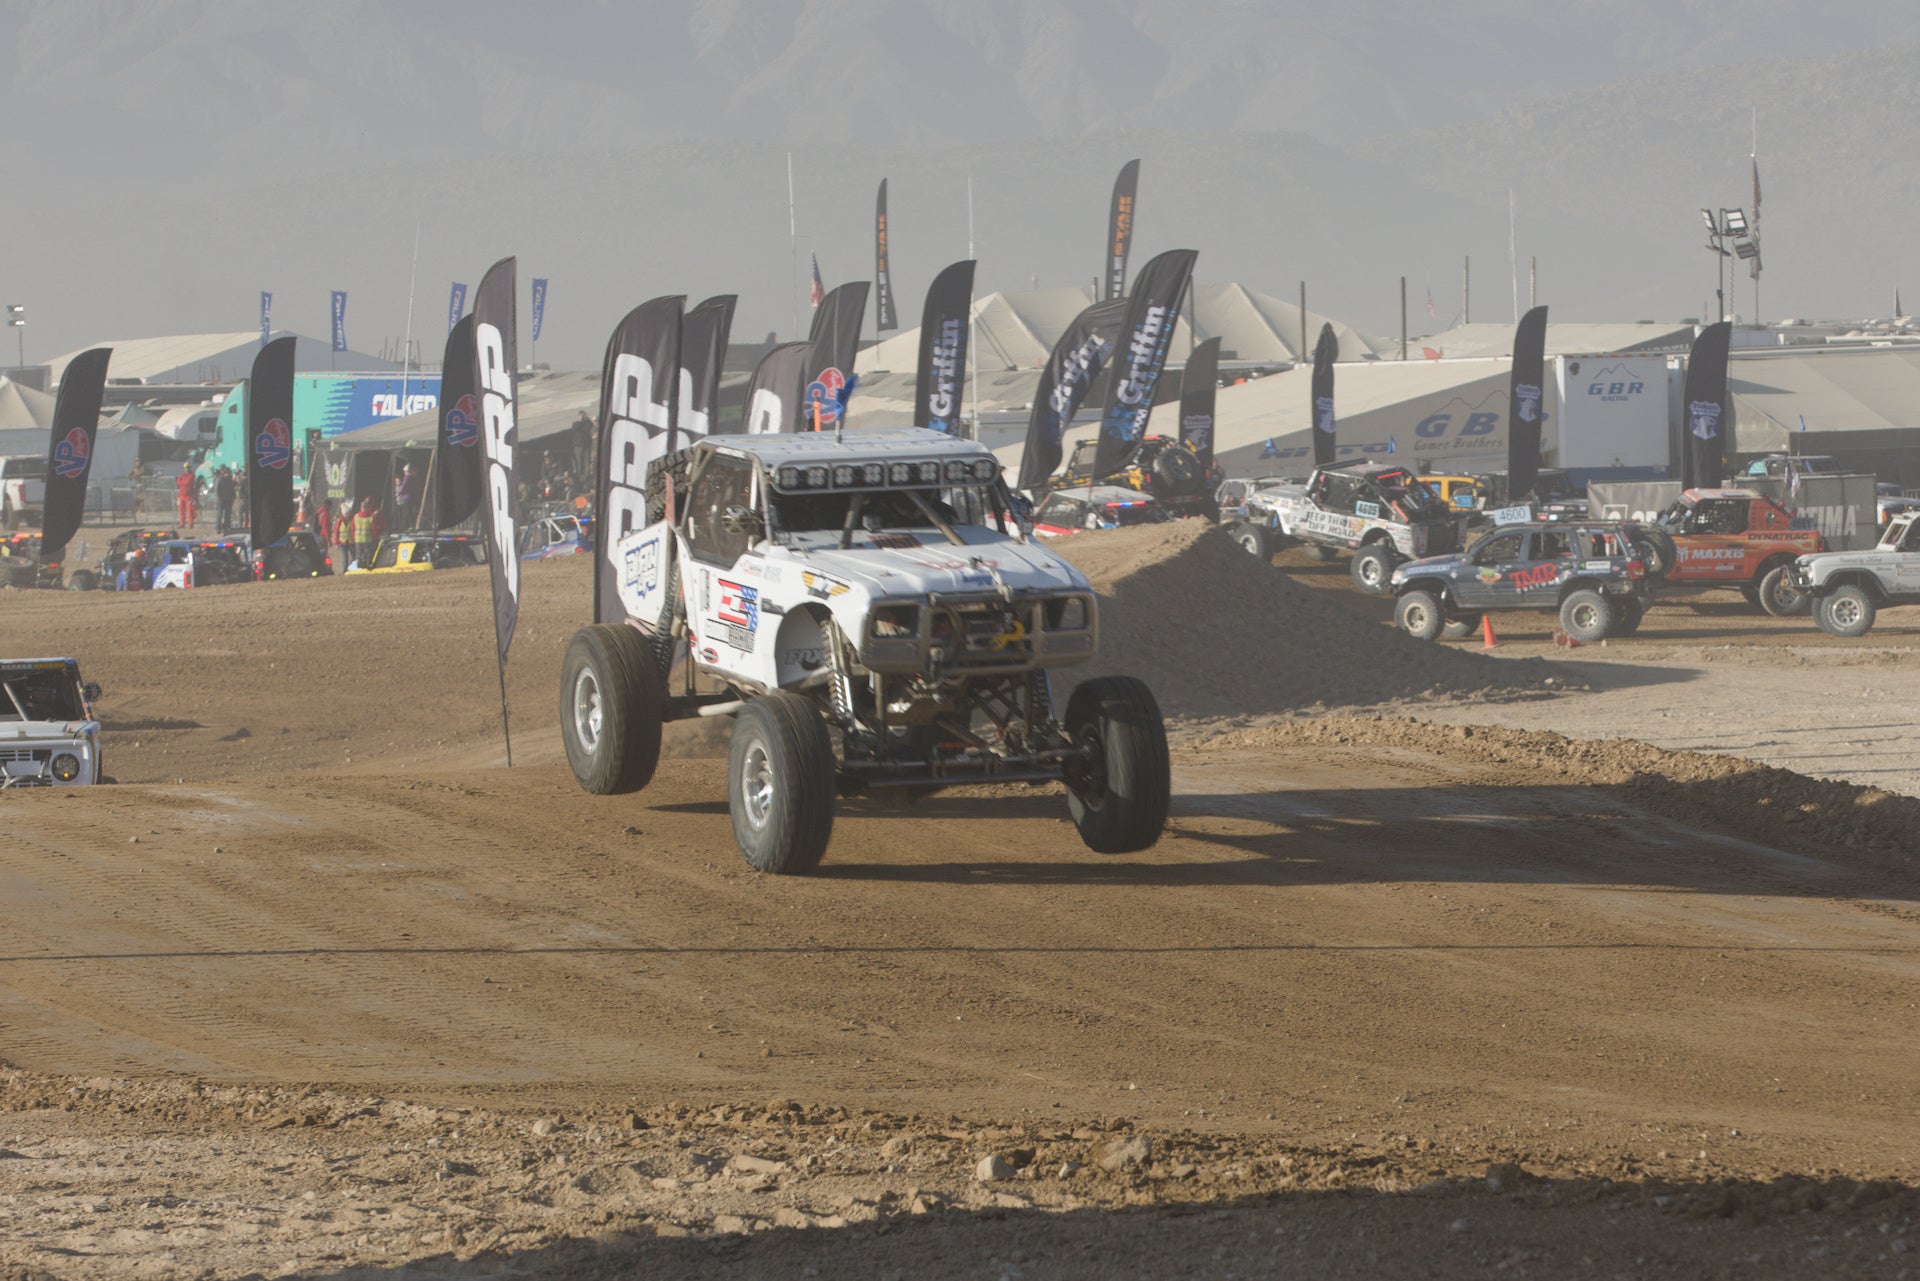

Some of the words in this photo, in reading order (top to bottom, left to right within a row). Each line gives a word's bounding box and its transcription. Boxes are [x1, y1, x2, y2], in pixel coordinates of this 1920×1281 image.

[929, 319, 959, 417] Griffin
[1116, 306, 1167, 406] Griffin
[1588, 382, 1644, 395] GBR
[372, 394, 437, 417] FALKEN
[446, 408, 479, 445] VP
[55, 439, 89, 476] VP
[255, 432, 289, 468] VP
[477, 323, 519, 605] PRP
[1499, 506, 1527, 521] 4600
[1797, 505, 1858, 536] TIMA
[1748, 533, 1809, 541] DYNATRAC
[1691, 548, 1745, 560] MAXXIS
[1508, 563, 1558, 589] TMR
